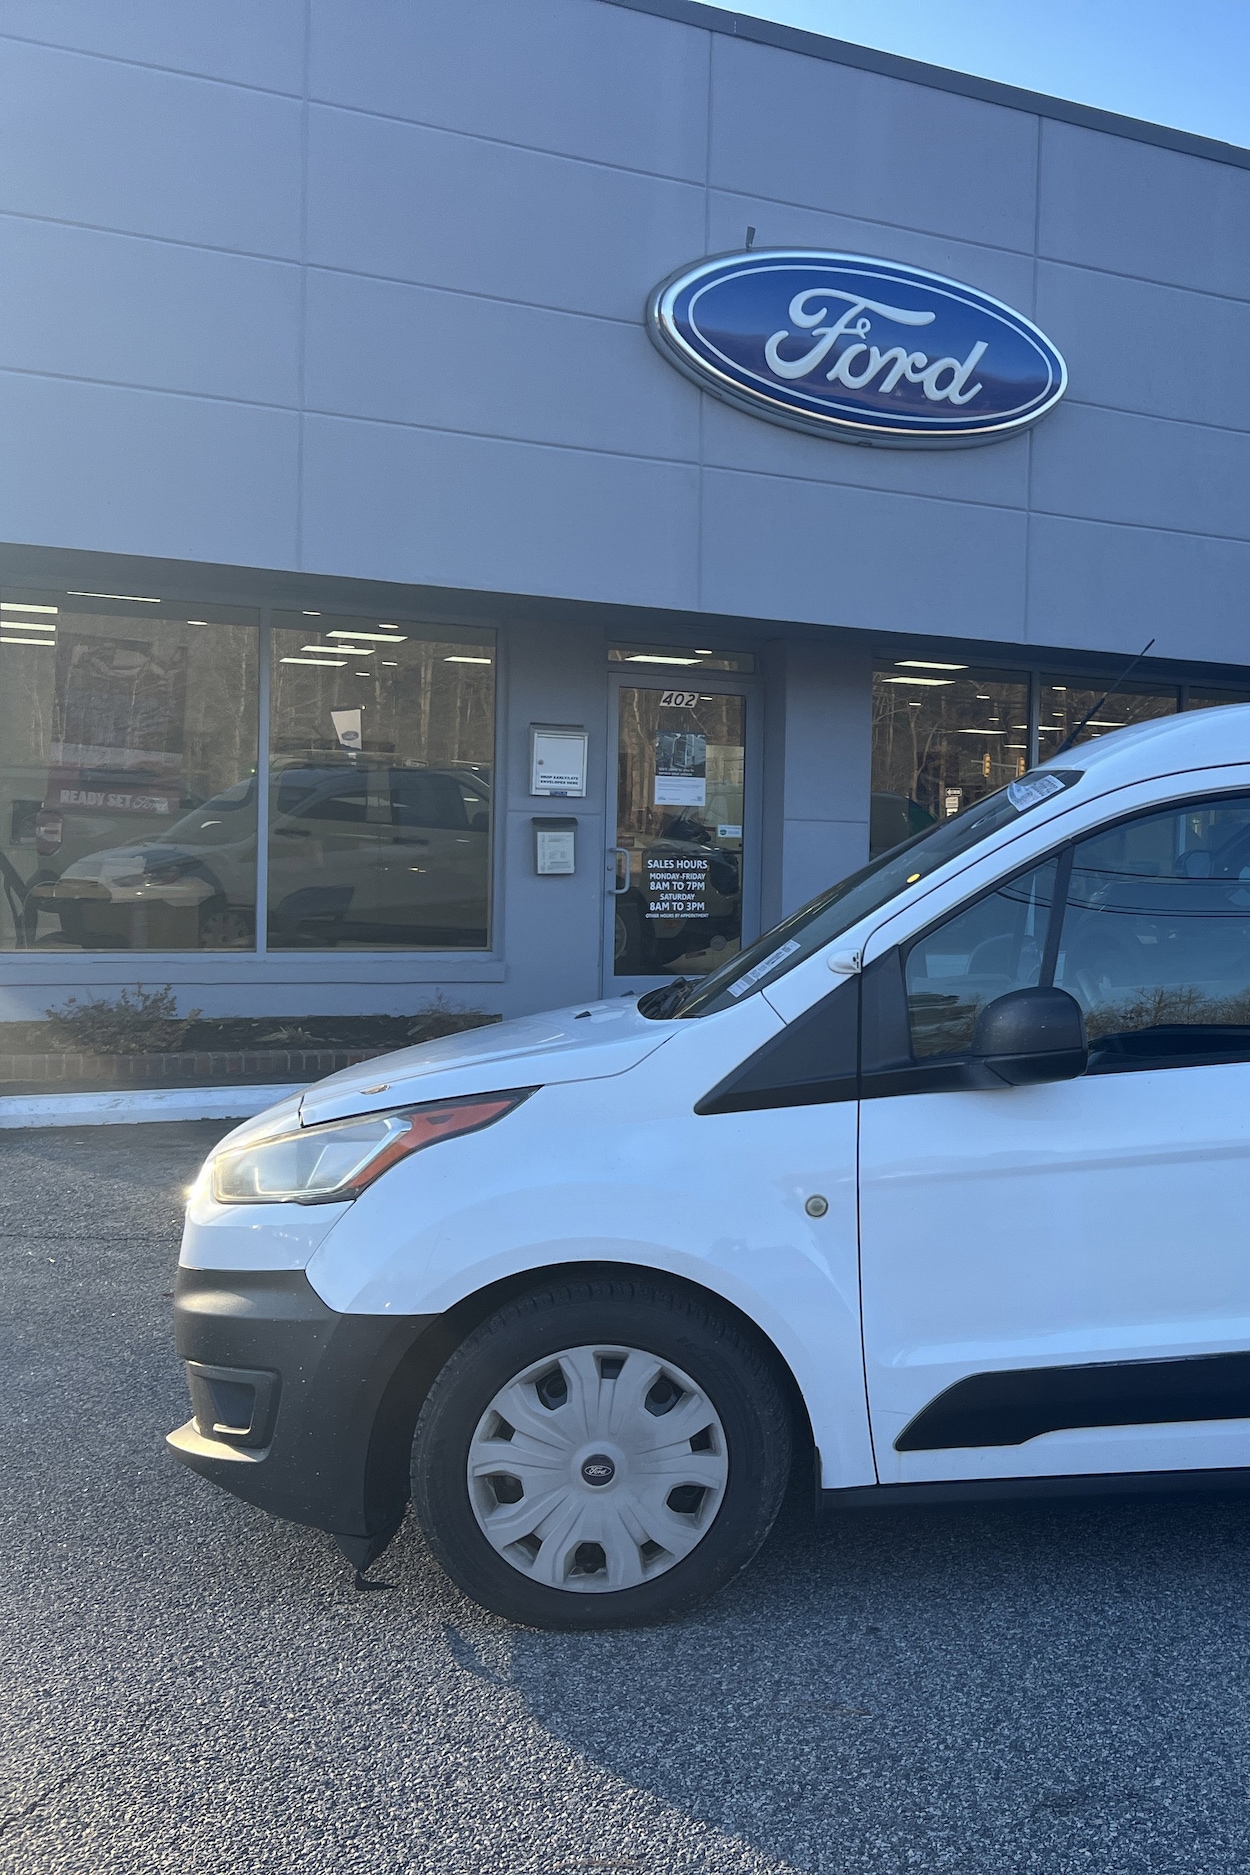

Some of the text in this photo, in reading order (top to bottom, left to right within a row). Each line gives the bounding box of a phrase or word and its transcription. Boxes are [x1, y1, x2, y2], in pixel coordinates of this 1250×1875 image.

[764, 287, 990, 407] Ford
[662, 692, 696, 707] 402
[60, 789, 105, 806] READY
[107, 793, 132, 808] SET
[647, 860, 708, 869] SALES HOURS
[650, 881, 705, 890] 8AM TO 7PM
[649, 902, 705, 911] 8AM TO 3PM
